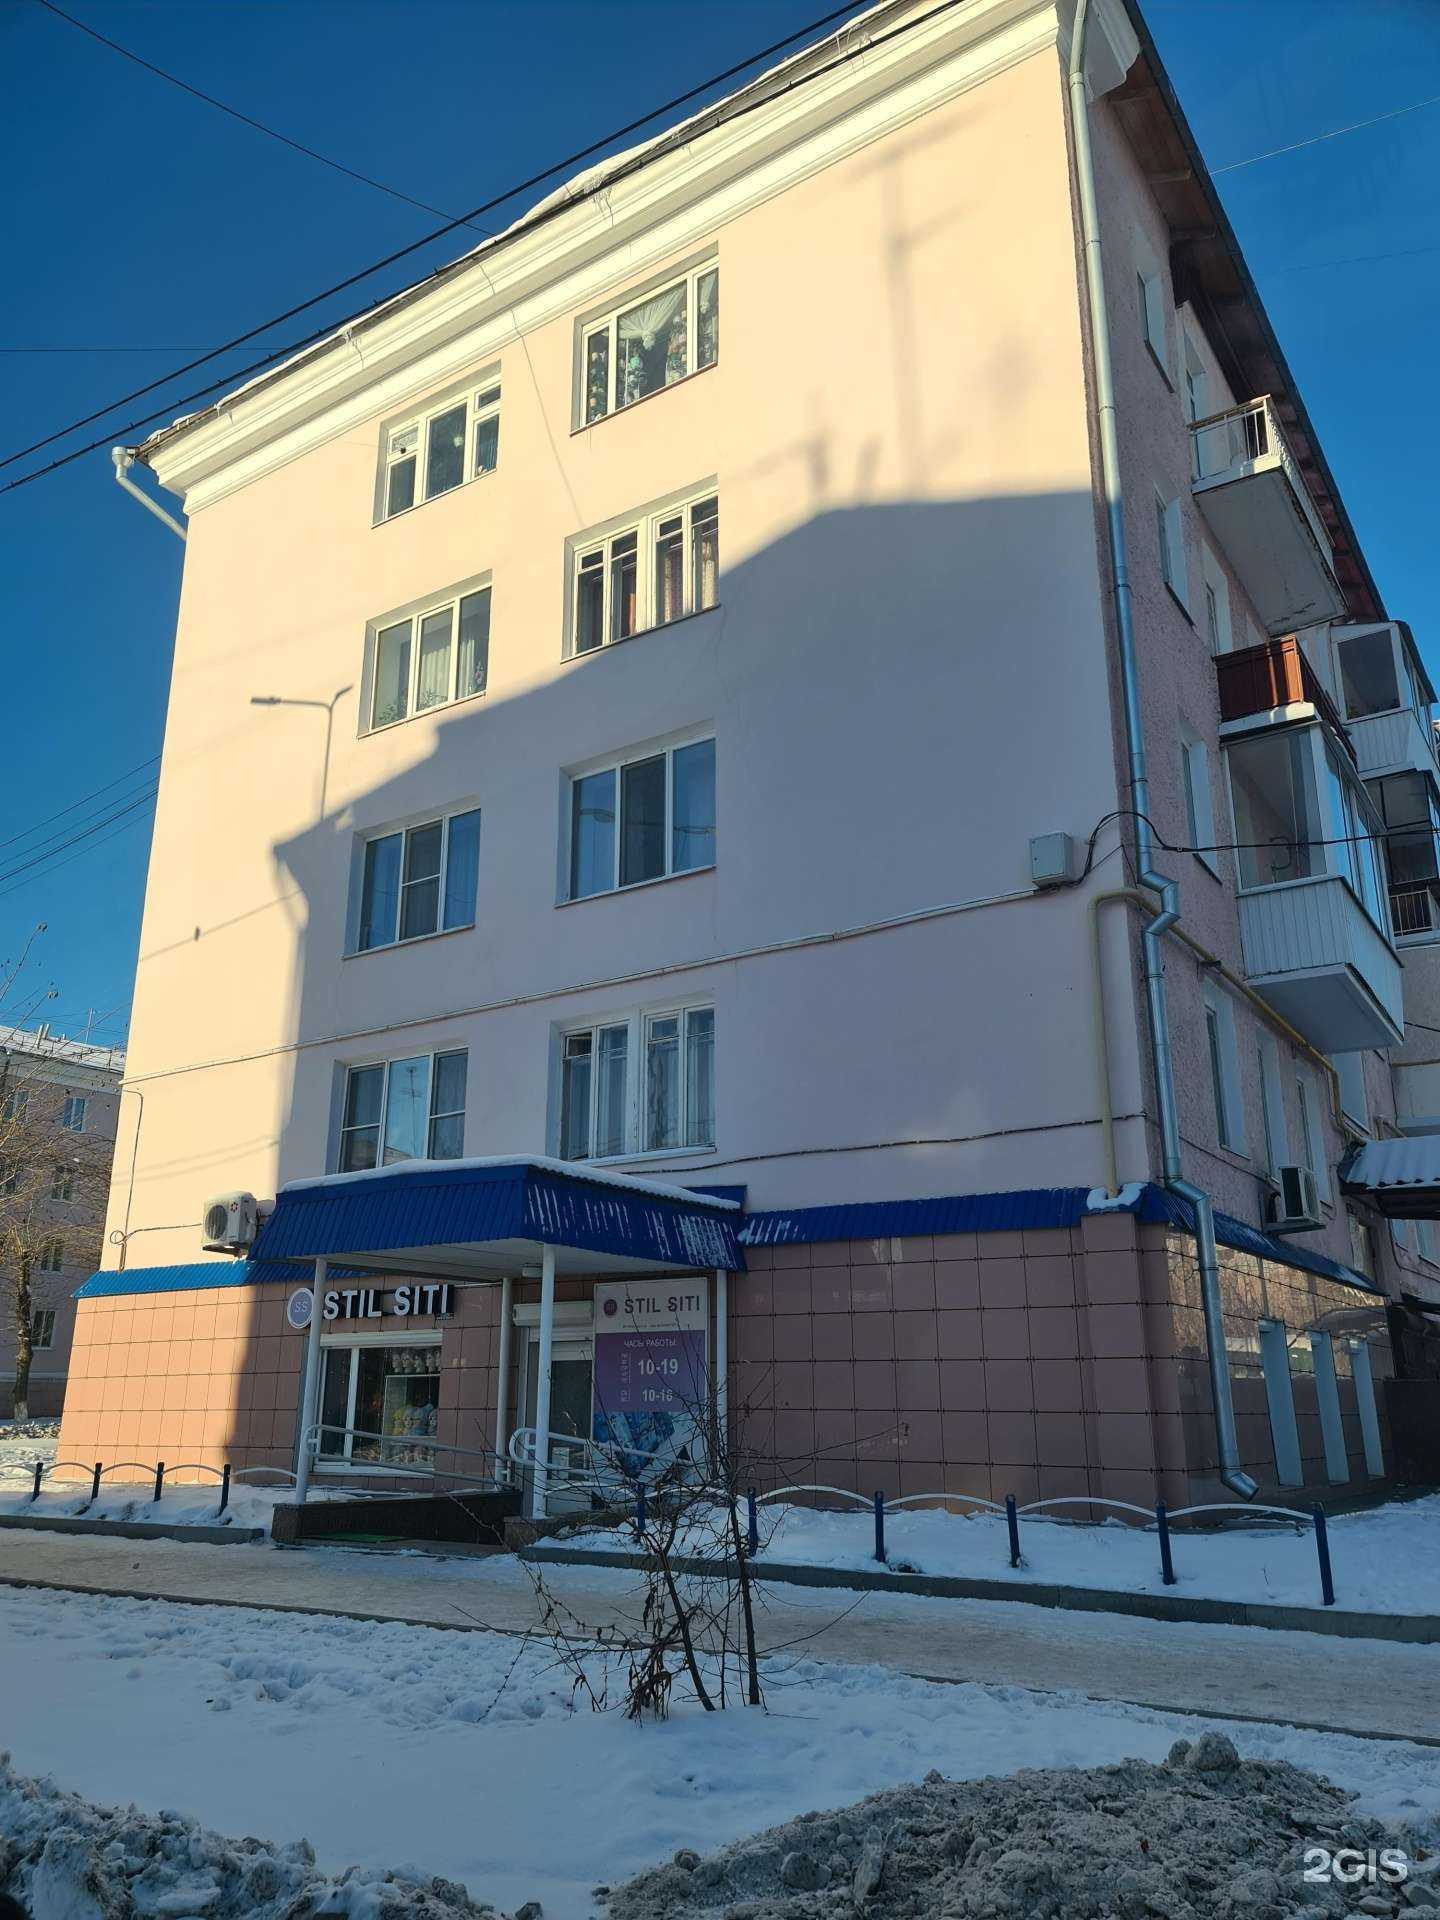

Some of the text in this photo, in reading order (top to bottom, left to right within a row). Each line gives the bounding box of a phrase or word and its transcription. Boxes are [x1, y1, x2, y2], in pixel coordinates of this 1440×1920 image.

[323, 1284, 449, 1320] STIL SITI
[624, 1298, 661, 1314] STIL
[668, 1296, 700, 1312] SITI
[646, 1338, 677, 1348] РАБОТЫ
[638, 1358, 679, 1375] 10-19
